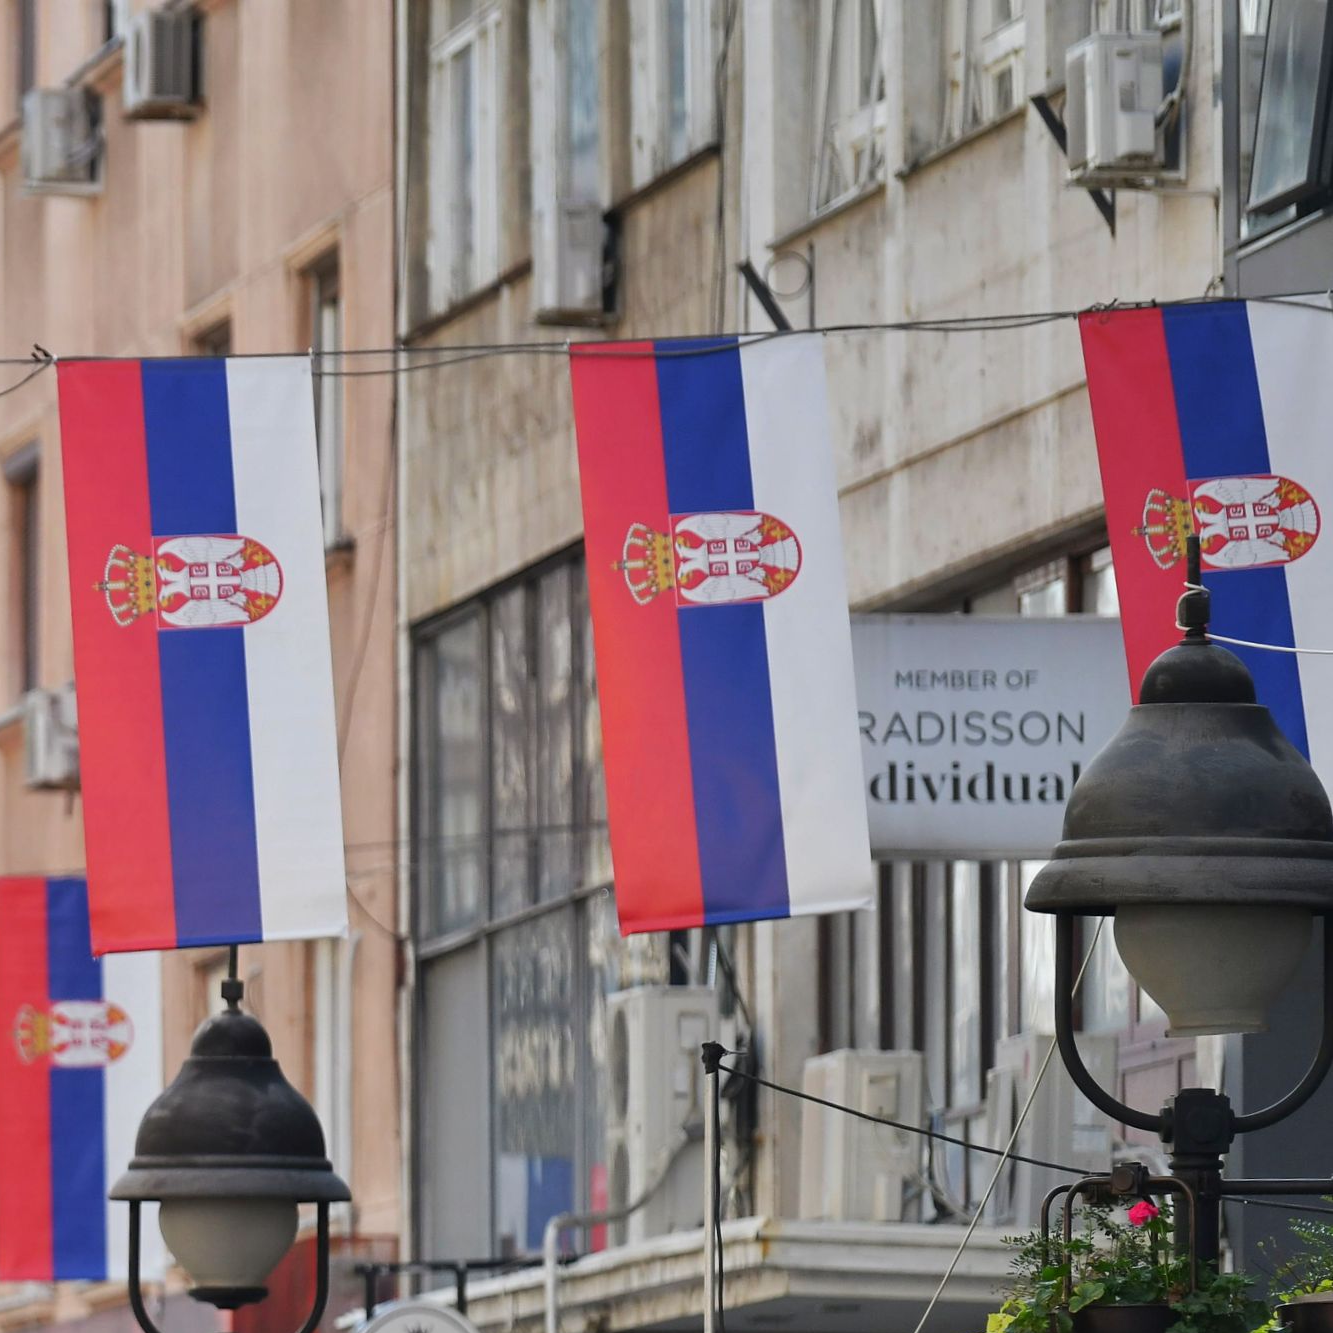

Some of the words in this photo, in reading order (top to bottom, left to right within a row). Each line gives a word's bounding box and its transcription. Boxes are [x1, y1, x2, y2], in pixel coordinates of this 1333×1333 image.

[894, 669, 997, 690] MEMBER
[1005, 669, 1039, 690] OF
[858, 710, 1085, 746] RADISSON
